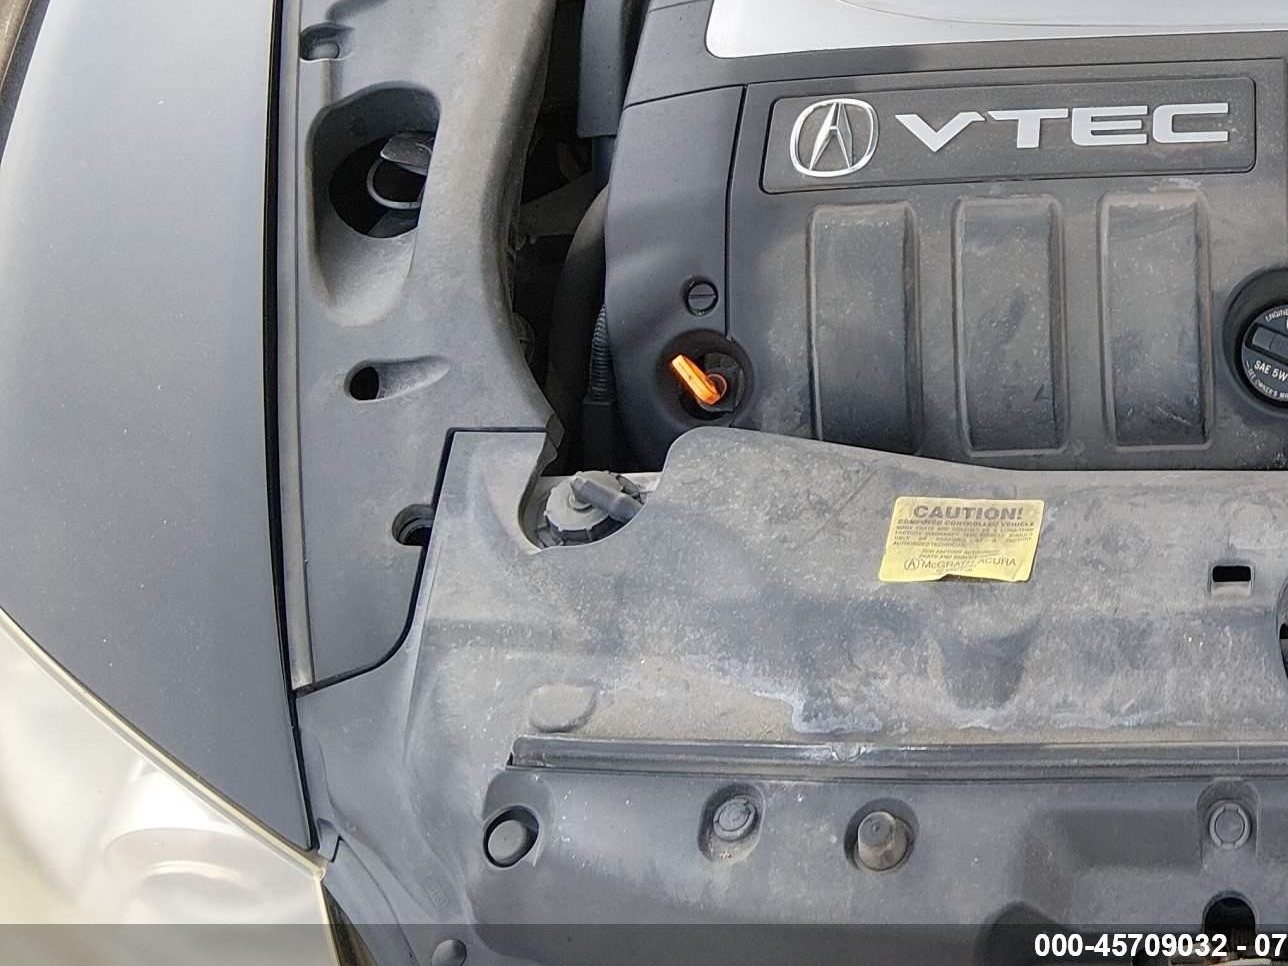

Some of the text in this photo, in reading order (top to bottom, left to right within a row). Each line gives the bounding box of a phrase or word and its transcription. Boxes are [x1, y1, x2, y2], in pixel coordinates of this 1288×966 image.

[895, 102, 1230, 153] VTEC
[1254, 360, 1271, 375] SAE
[913, 505, 1024, 521] CAUTION!
[977, 557, 1016, 566] ACURA
